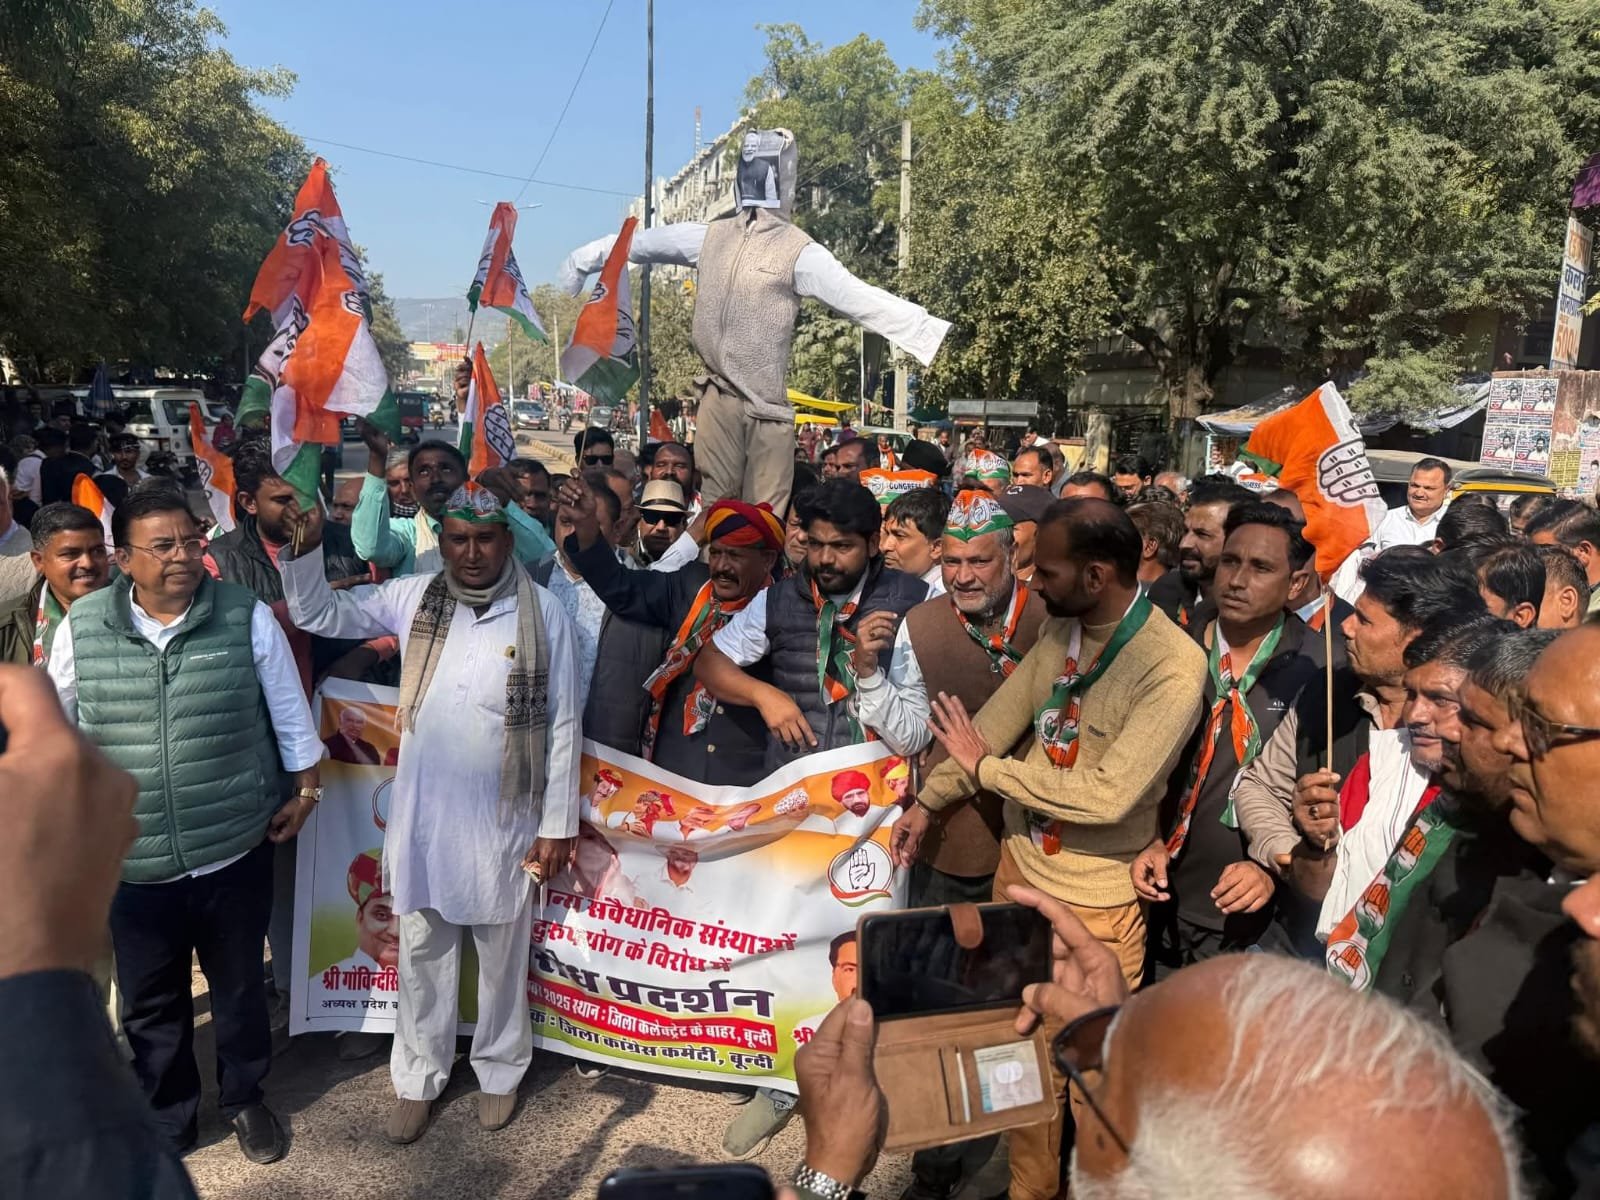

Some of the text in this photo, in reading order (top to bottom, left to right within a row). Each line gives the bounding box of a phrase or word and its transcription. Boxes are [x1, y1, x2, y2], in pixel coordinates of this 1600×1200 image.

[625, 938, 647, 960] के
[646, 942, 707, 972] विरोध
[322, 965, 341, 991] श्री
[605, 975, 775, 1018] प्रदर्शन
[544, 988, 571, 1011] 2025
[571, 999, 600, 1020] स्थान
[608, 1006, 638, 1032] जिला
[688, 1022, 703, 1036] के
[743, 1028, 772, 1048] बून्दी
[559, 1016, 599, 1044] जिला
[728, 1053, 773, 1069] बून्दी
